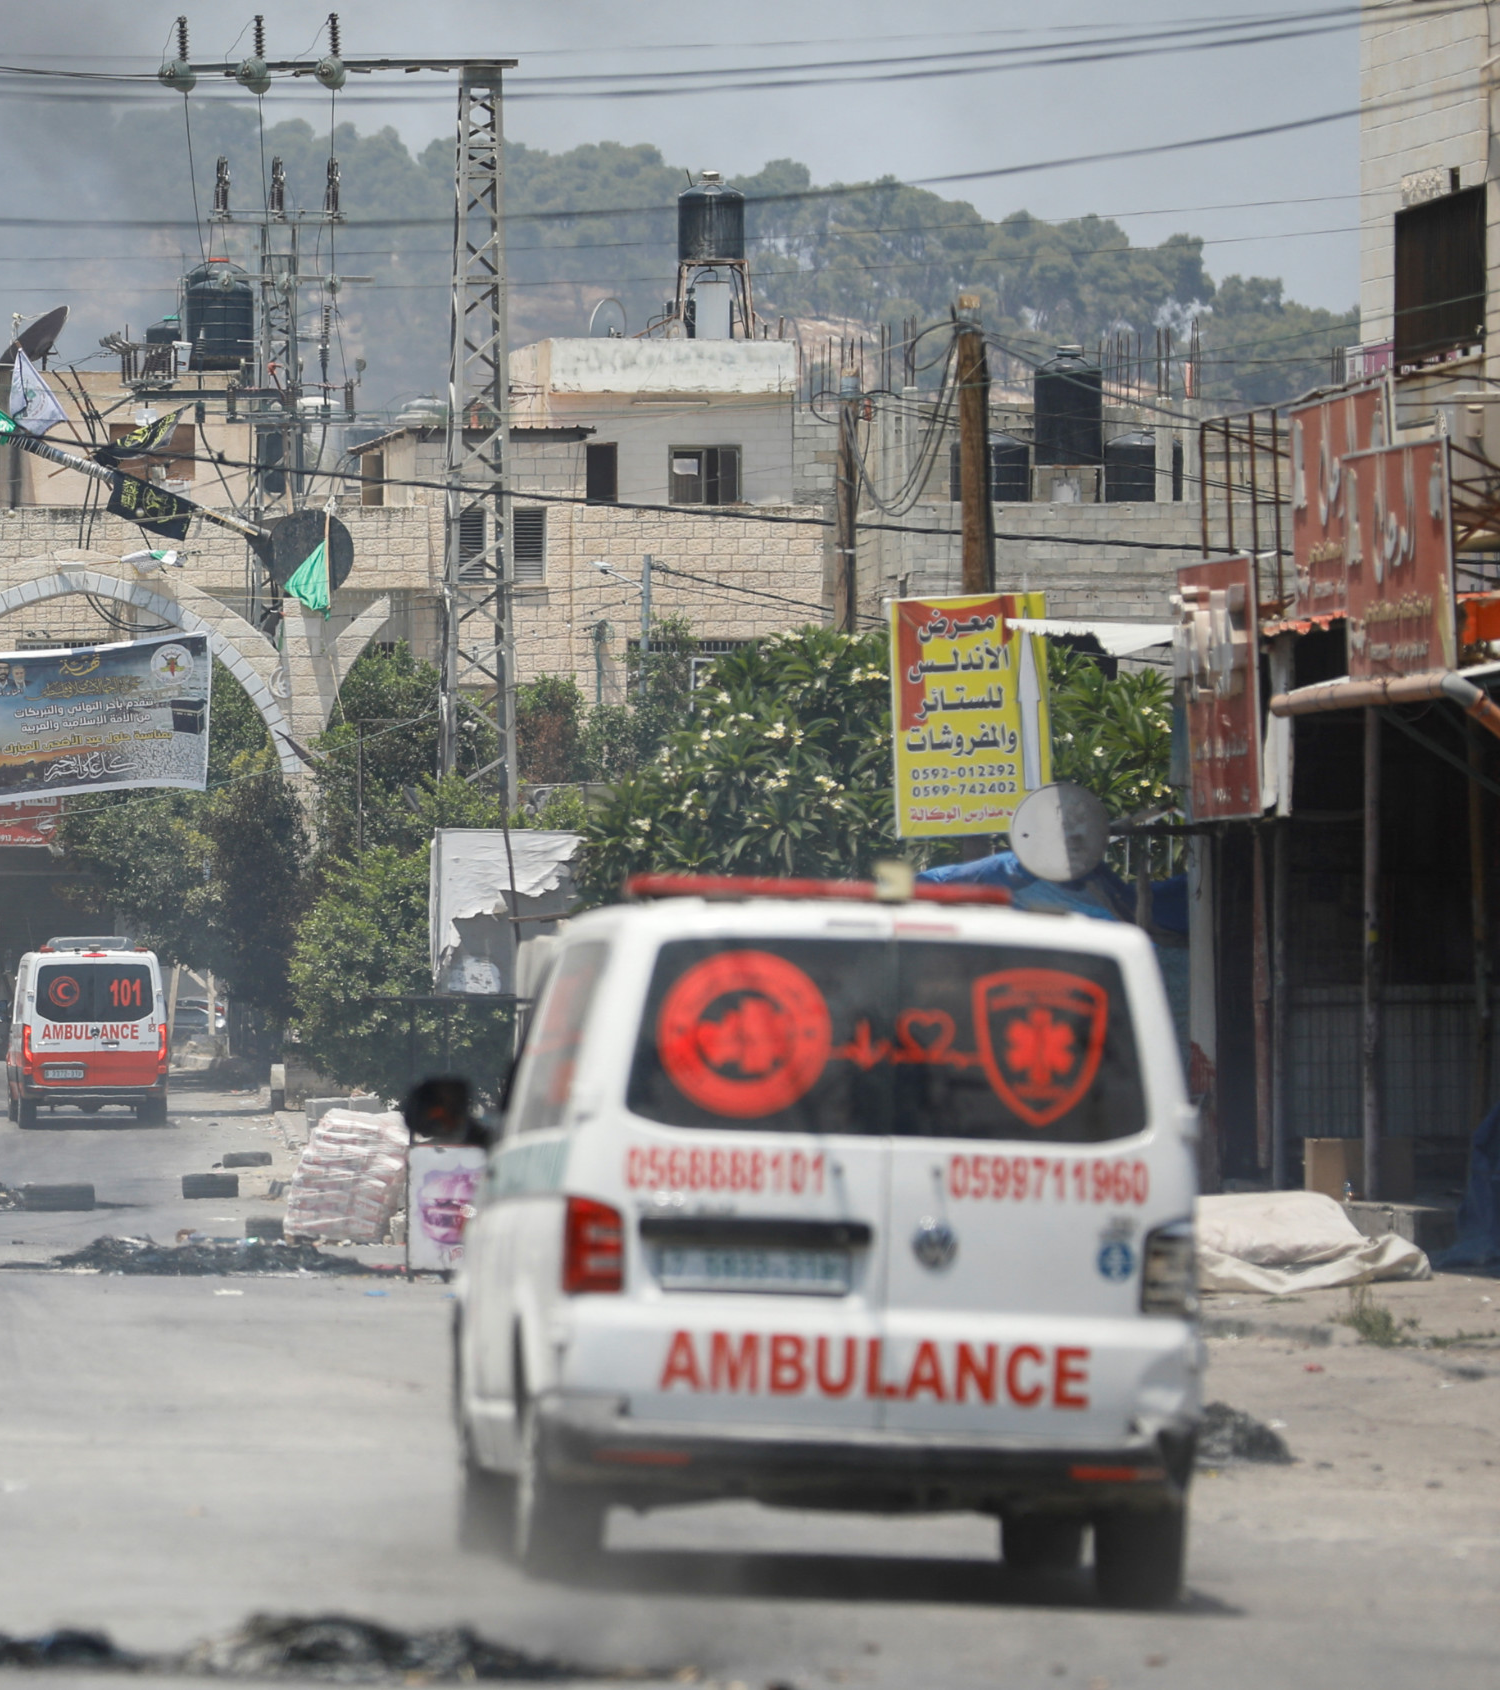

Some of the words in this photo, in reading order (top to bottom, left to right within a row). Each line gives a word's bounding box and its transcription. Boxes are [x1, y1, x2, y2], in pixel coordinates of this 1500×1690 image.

[917, 609, 996, 643] معرض
[908, 640, 1010, 683] الأندلس
[67, 700, 103, 716] التهاني
[915, 685, 1005, 720] للستائر
[13, 704, 65, 721] والتبريكات
[109, 711, 134, 724] الأمة
[136, 713, 152, 723] من
[21, 719, 60, 734] والعربية
[85, 736, 104, 747] عيد
[105, 733, 132, 746] حلول
[133, 729, 173, 742] بمناسبة
[906, 723, 1018, 757] والمفروشات
[911, 763, 1016, 781] 0592-012292
[912, 781, 1017, 798] 0599-742402
[909, 806, 961, 823] الوكالة
[109, 978, 142, 1007] 101
[41, 1023, 140, 1040] AMBULANCE
[626, 1146, 827, 1194] 0568888101
[948, 1154, 1149, 1205] 0599711960
[660, 1330, 1090, 1410] AMBULANCE
